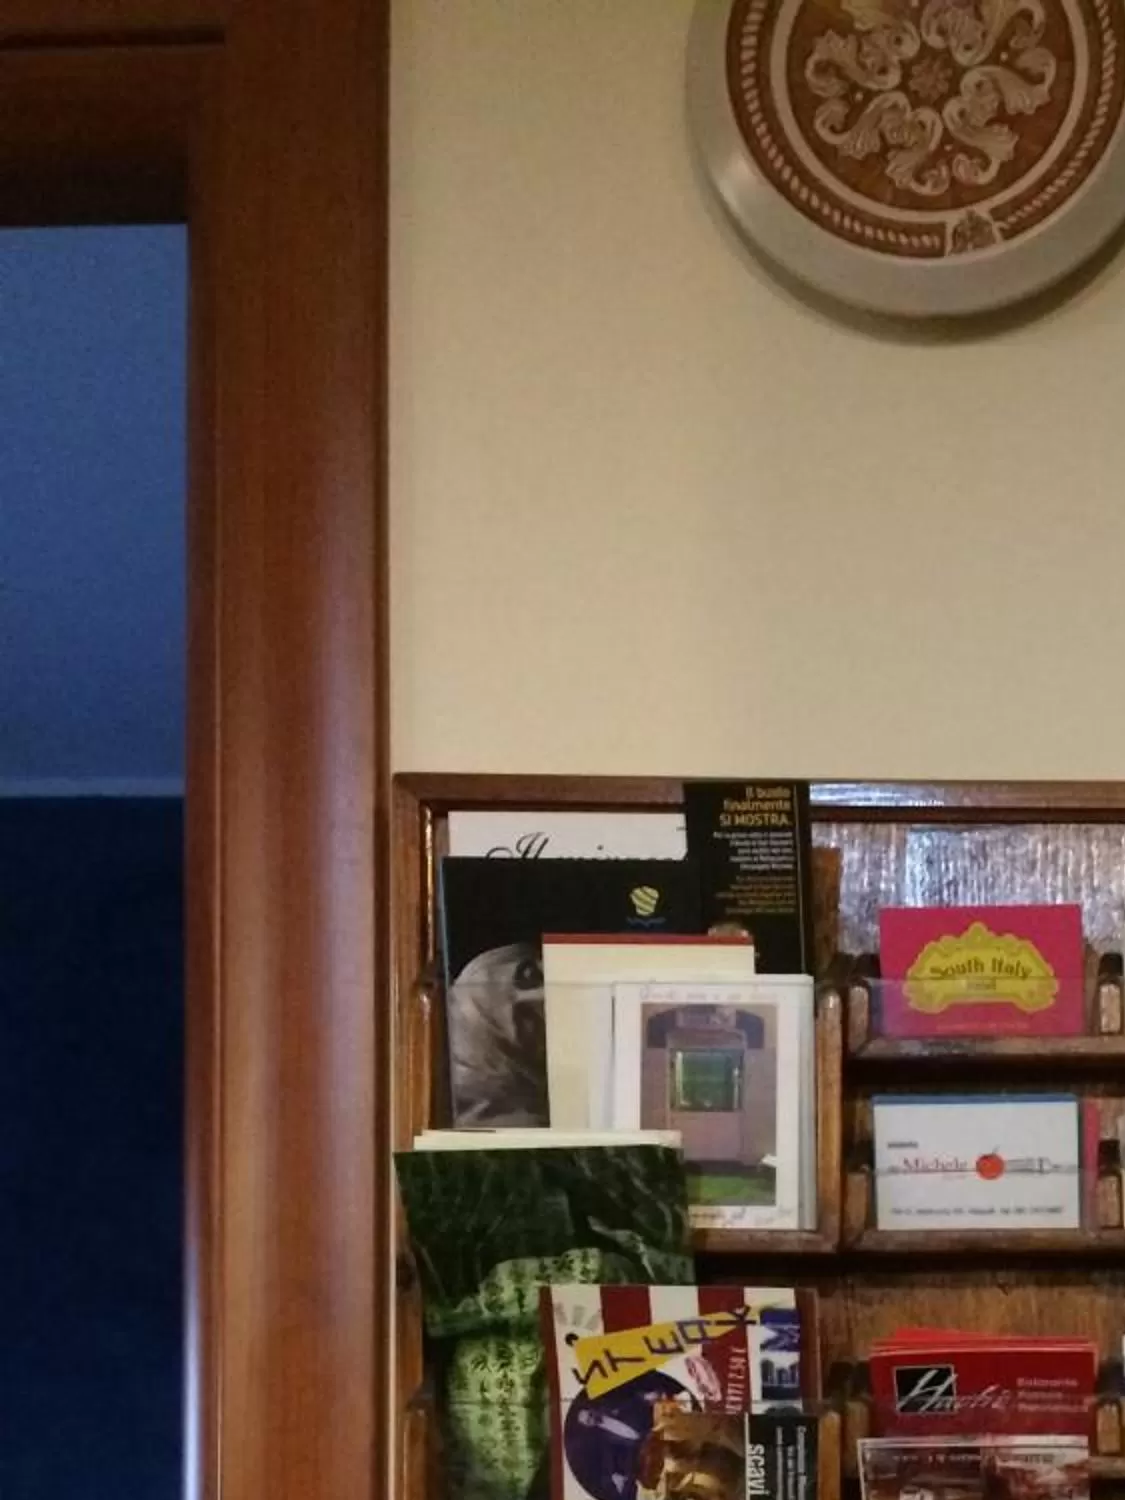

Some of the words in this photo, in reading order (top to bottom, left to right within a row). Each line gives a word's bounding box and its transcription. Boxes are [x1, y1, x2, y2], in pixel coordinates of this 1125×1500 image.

[930, 956, 984, 980] South
[991, 957, 1032, 980] Italy
[749, 1443, 770, 1496] scavi
